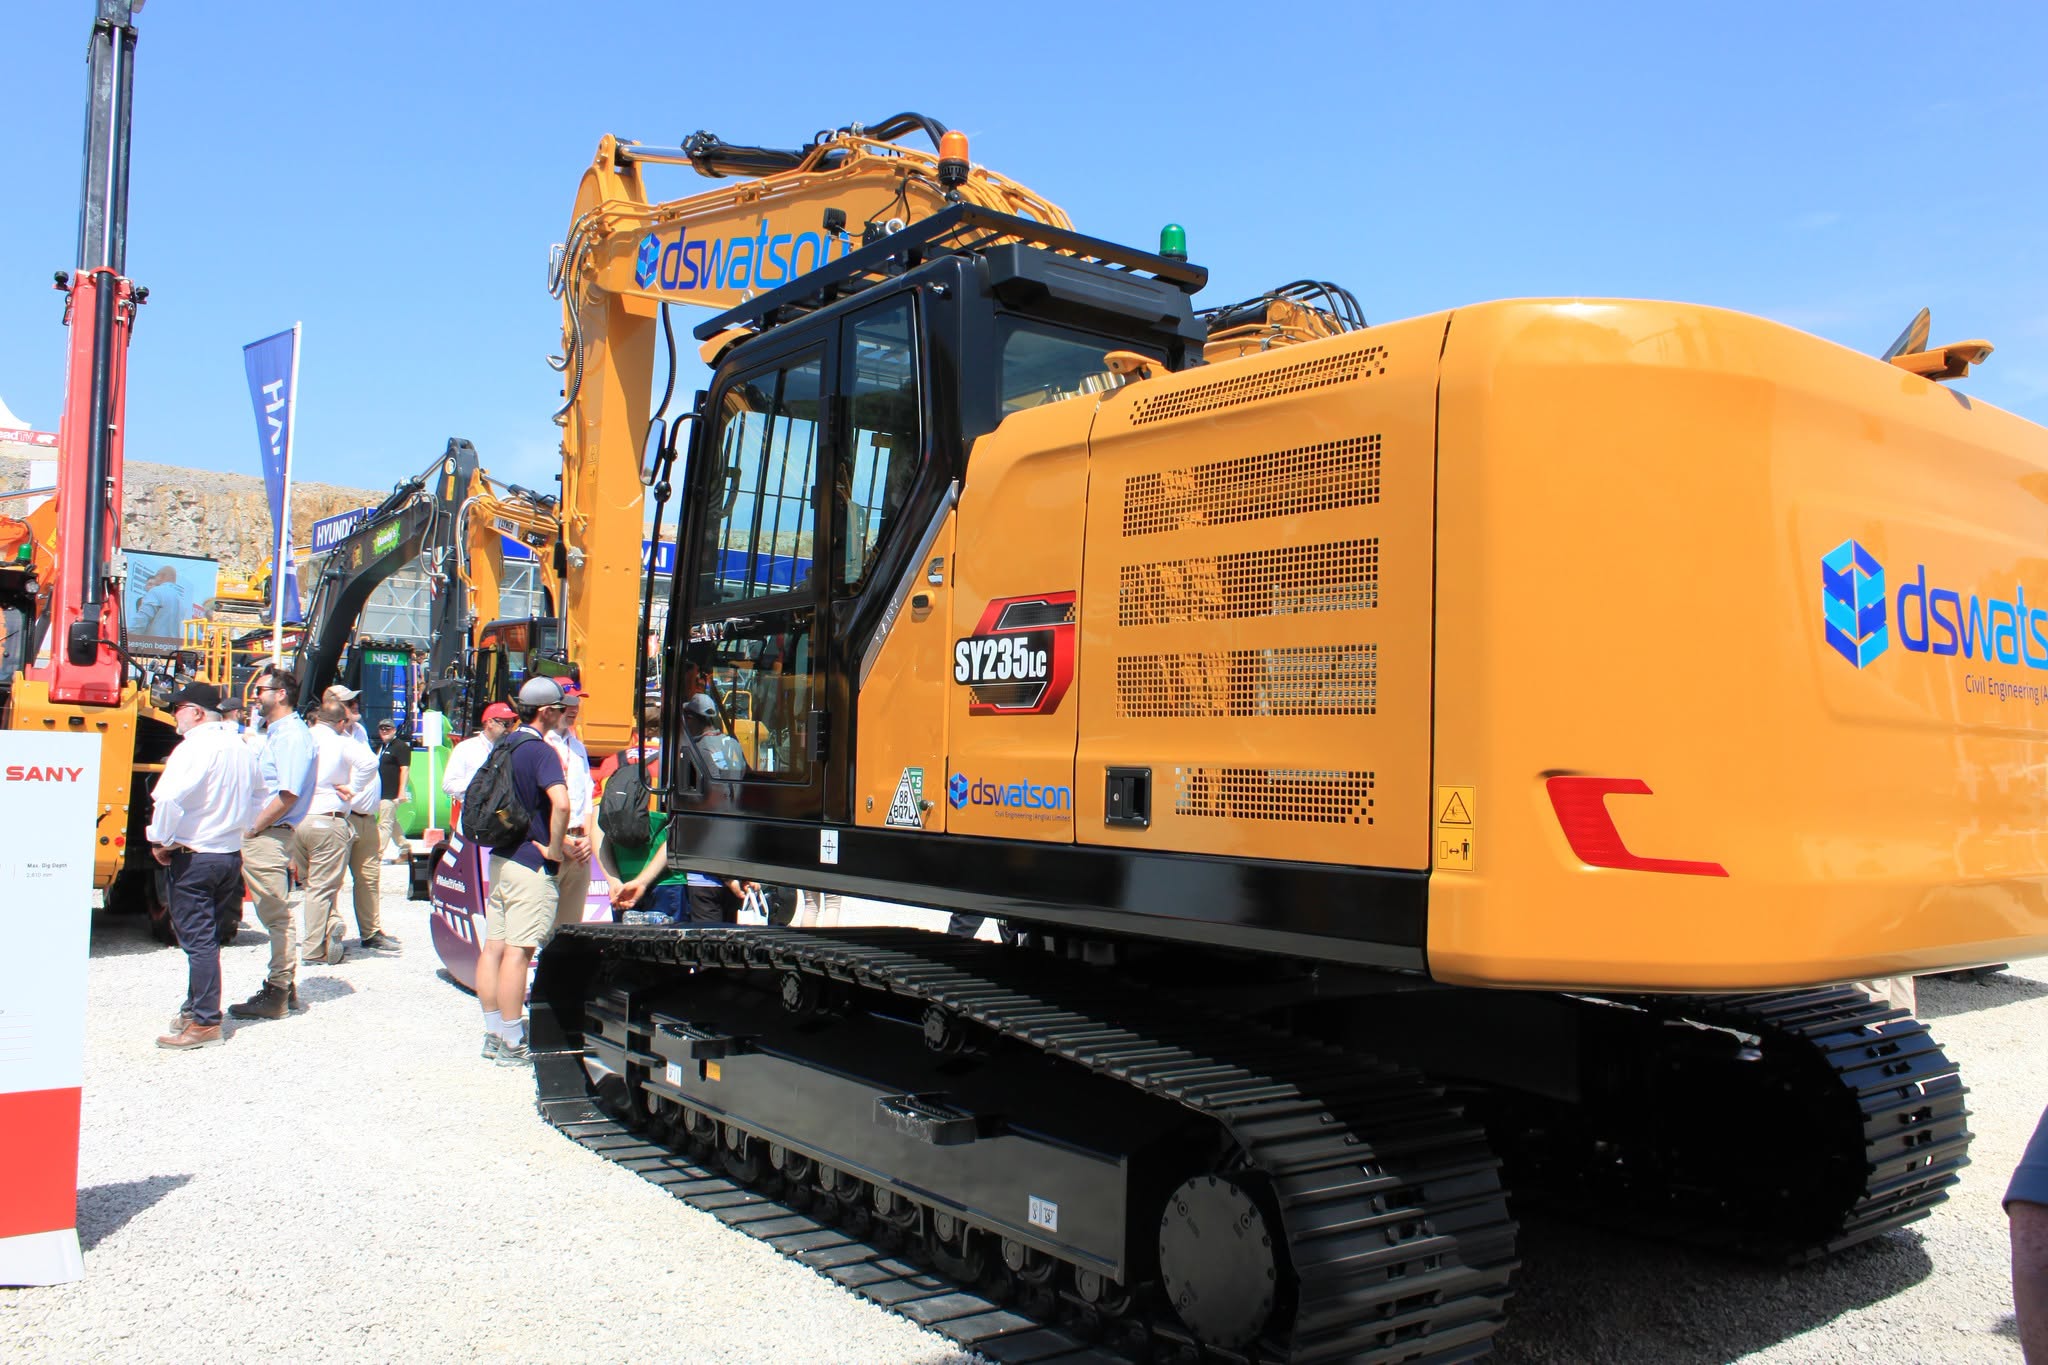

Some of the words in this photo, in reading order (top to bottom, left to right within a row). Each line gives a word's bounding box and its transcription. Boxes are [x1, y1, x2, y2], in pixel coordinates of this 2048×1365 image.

[372, 653, 399, 664] NEW
[1965, 674, 1986, 695] Civil
[1988, 677, 2040, 706] Engineering
[5, 765, 84, 782] SANY
[971, 777, 1071, 810] dswatson
